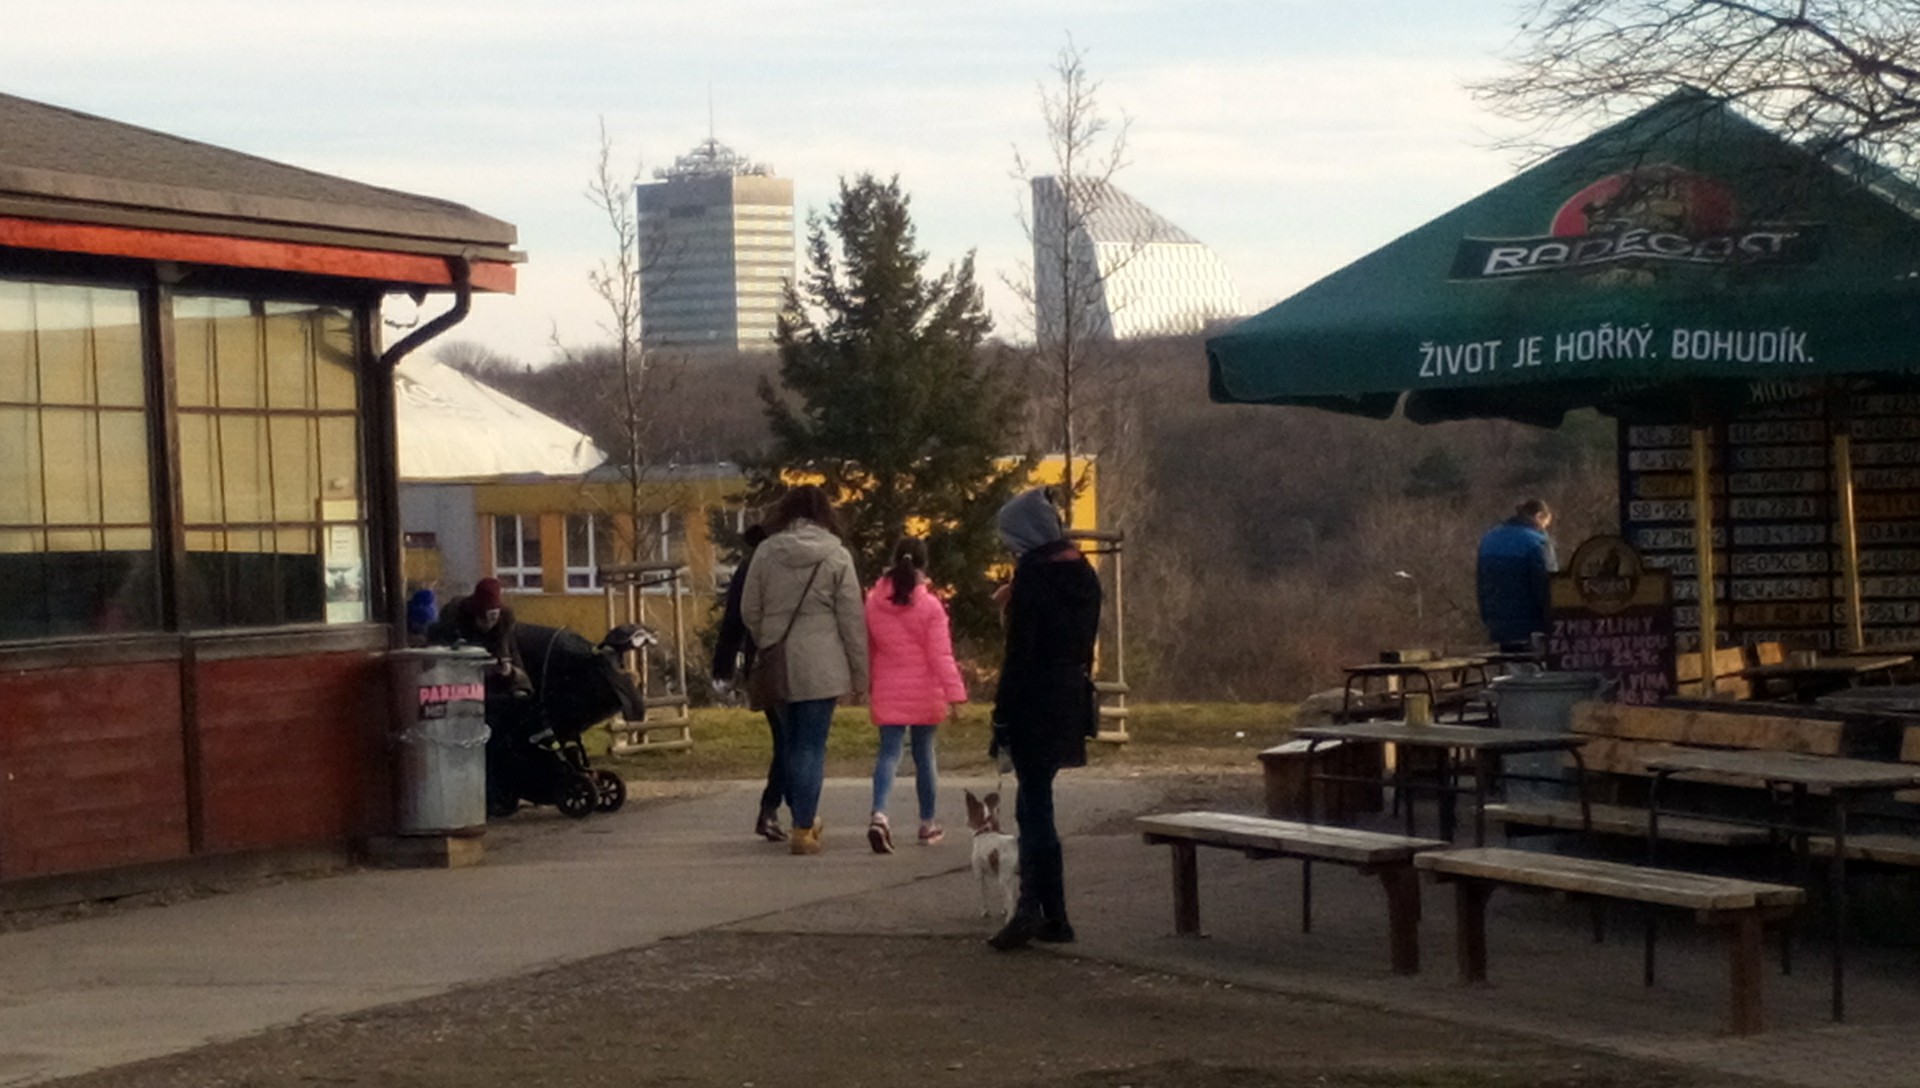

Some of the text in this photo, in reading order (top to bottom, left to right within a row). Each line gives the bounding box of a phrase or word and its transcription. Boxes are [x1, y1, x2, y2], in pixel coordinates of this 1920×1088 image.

[1418, 323, 1815, 378] ŽIVOT JE HOŘKÝ. BOHUDÍK.
